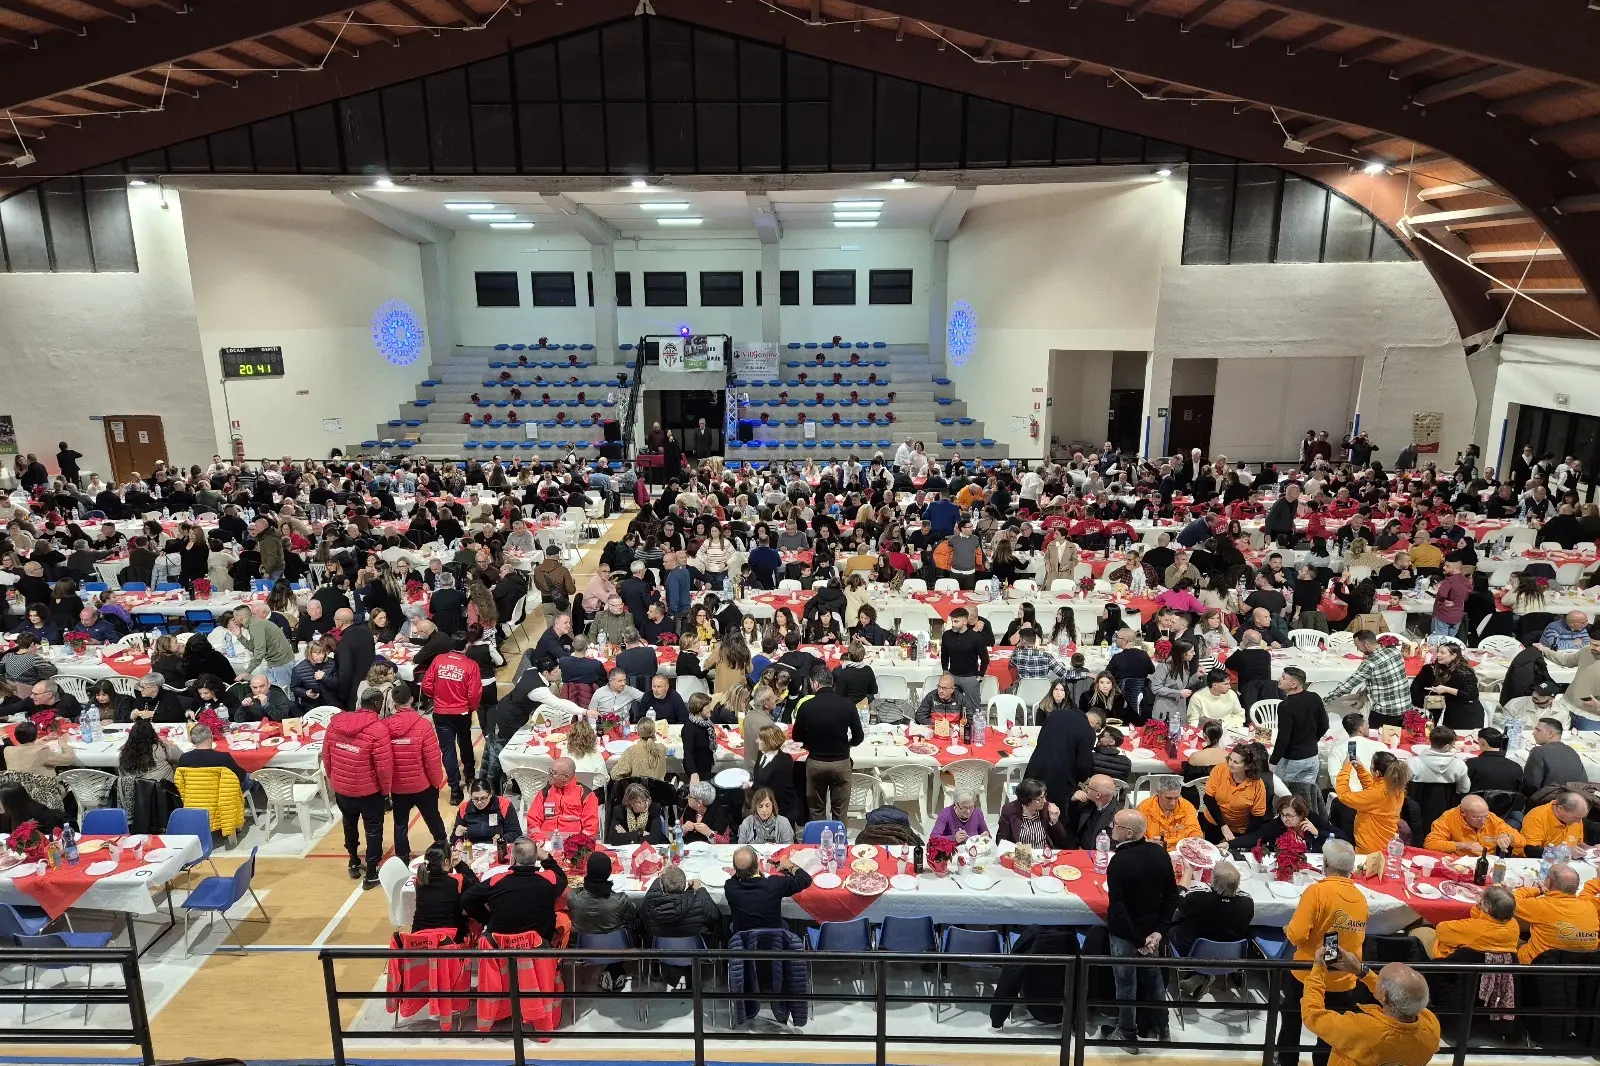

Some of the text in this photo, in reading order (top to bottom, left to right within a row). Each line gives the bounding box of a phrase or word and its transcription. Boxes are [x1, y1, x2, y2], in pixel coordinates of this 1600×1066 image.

[240, 364, 271, 374] 20 41
[439, 664, 464, 674] FORNACI
[438, 670, 463, 680] SCANU
